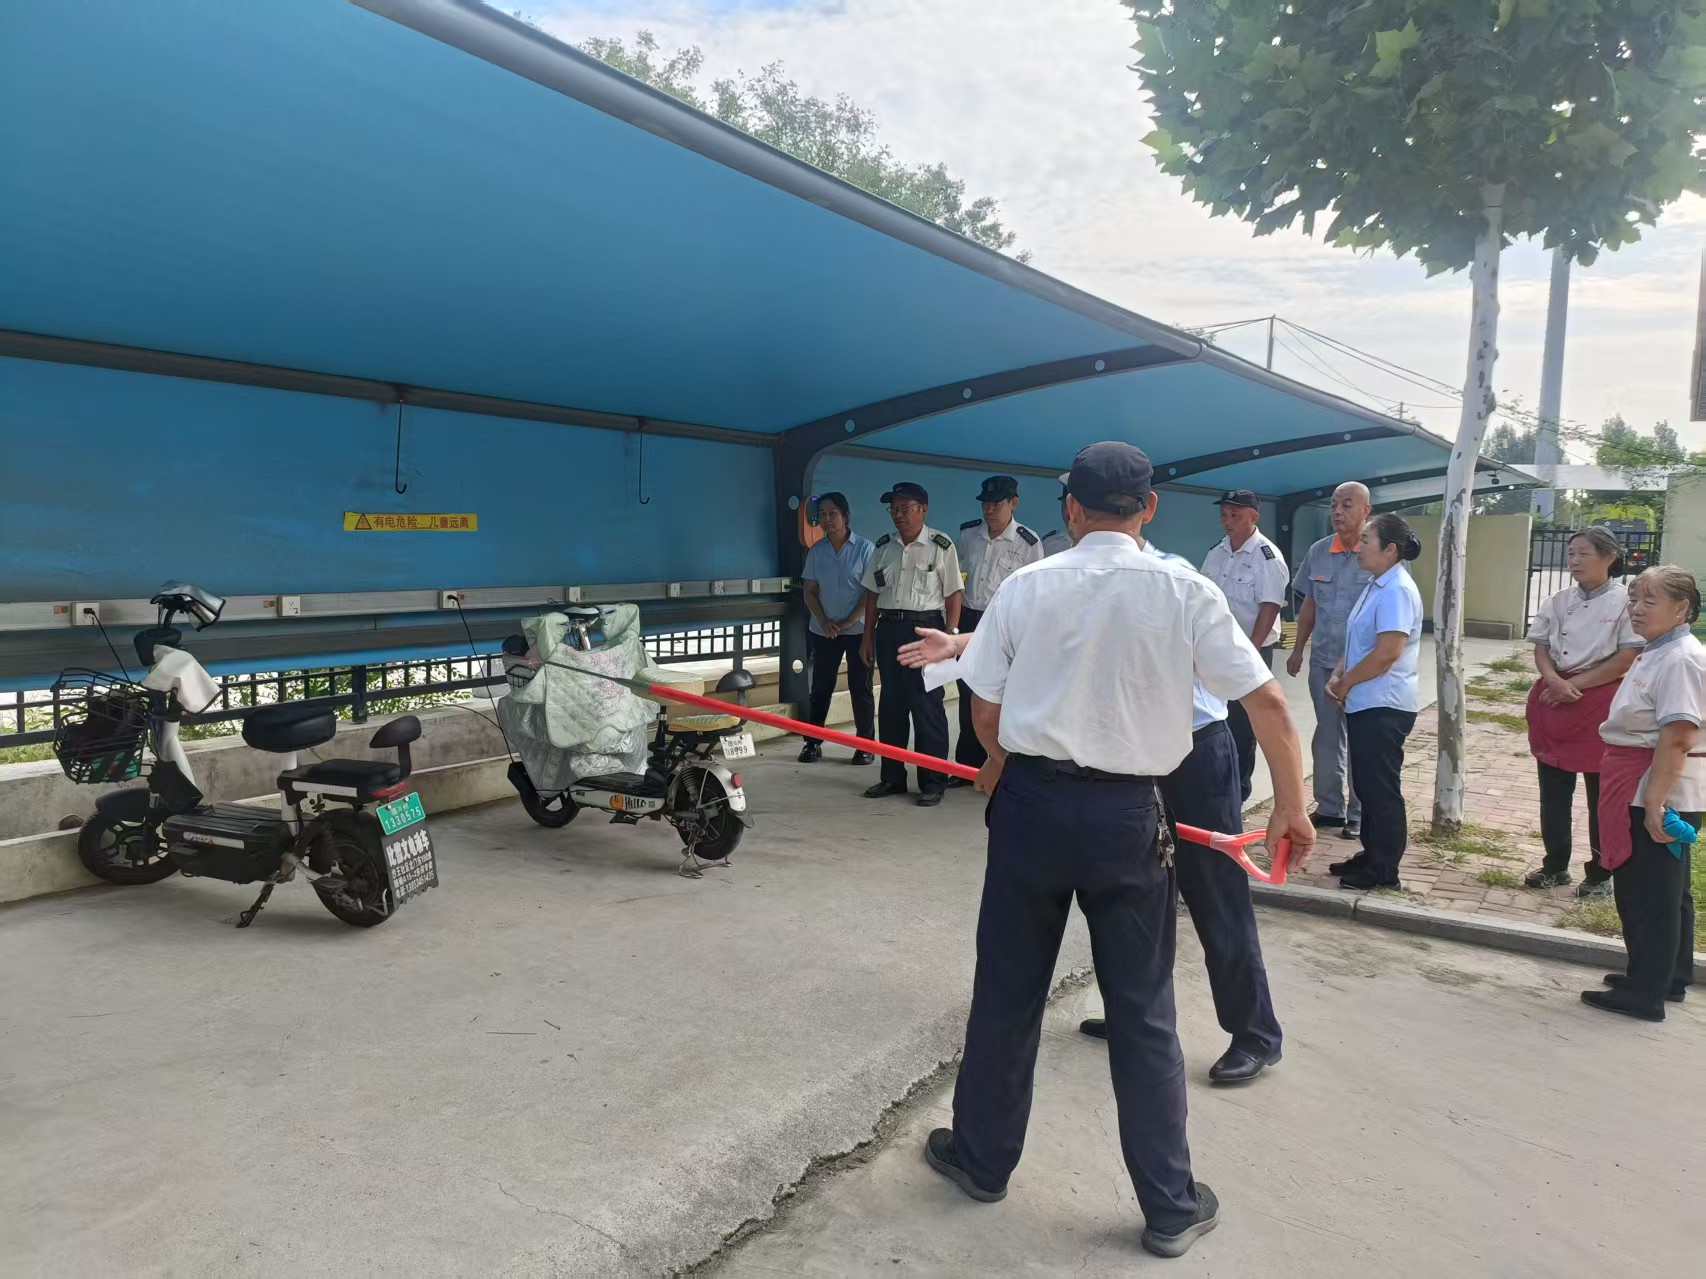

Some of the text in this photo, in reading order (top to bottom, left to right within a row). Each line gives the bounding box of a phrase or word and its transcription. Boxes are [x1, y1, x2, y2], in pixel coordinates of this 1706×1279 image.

[374, 515, 469, 529] 有电危险 儿童远离
[385, 806, 422, 830] 1330575
